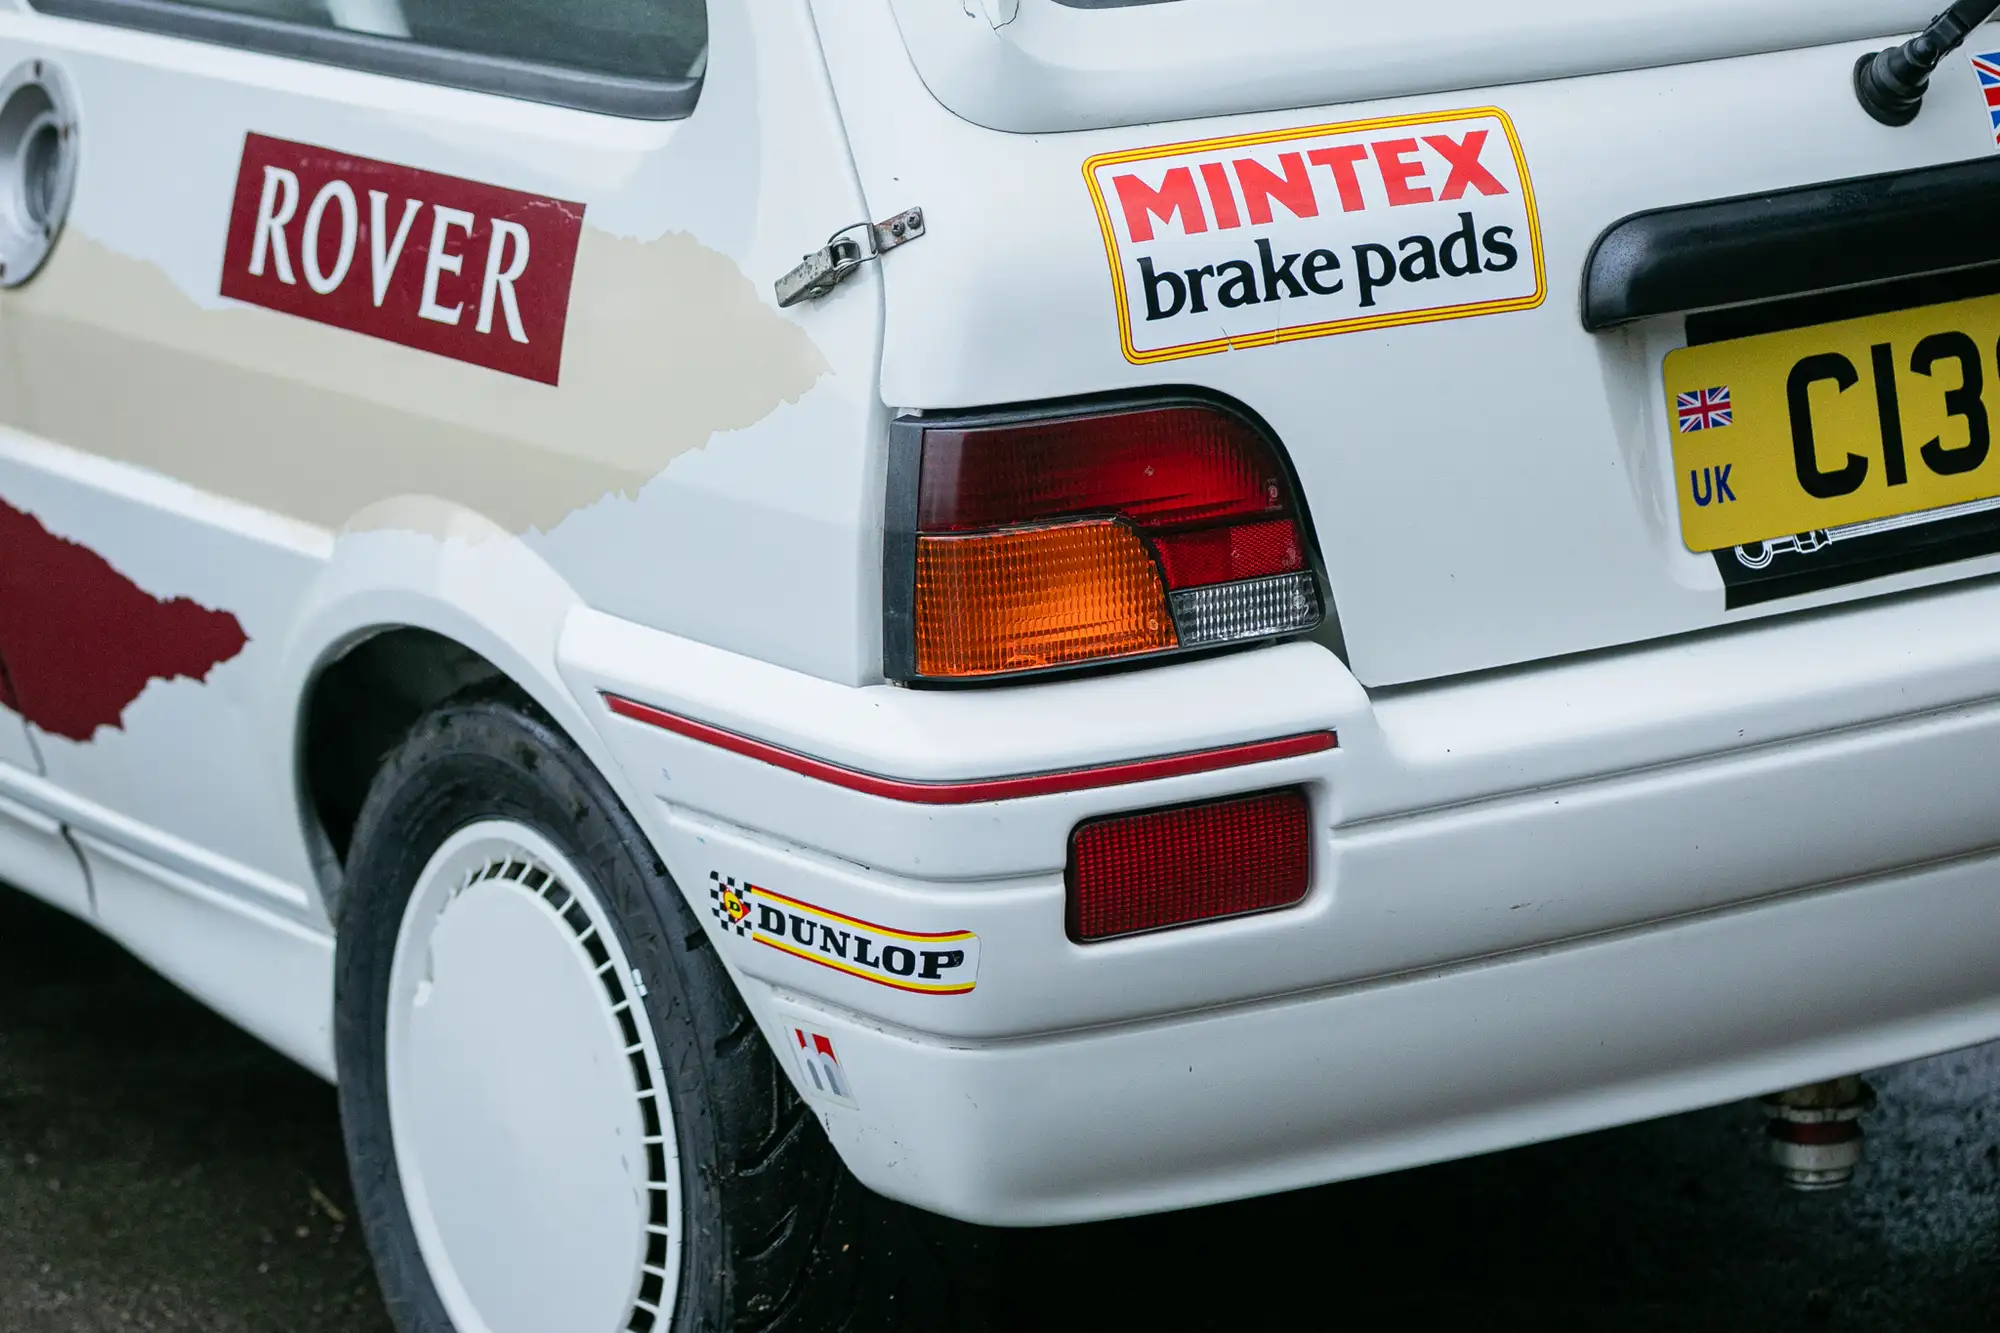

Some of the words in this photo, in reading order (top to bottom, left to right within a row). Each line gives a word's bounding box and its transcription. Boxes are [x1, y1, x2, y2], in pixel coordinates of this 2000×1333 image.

[1112, 130, 1509, 243] MINTEX
[248, 165, 531, 344] ROVER
[1137, 238, 1343, 321] brake
[1352, 212, 1518, 307] pads
[1786, 331, 2000, 499] C13
[1690, 464, 1737, 507] UK
[758, 902, 965, 980] DUNLOP
